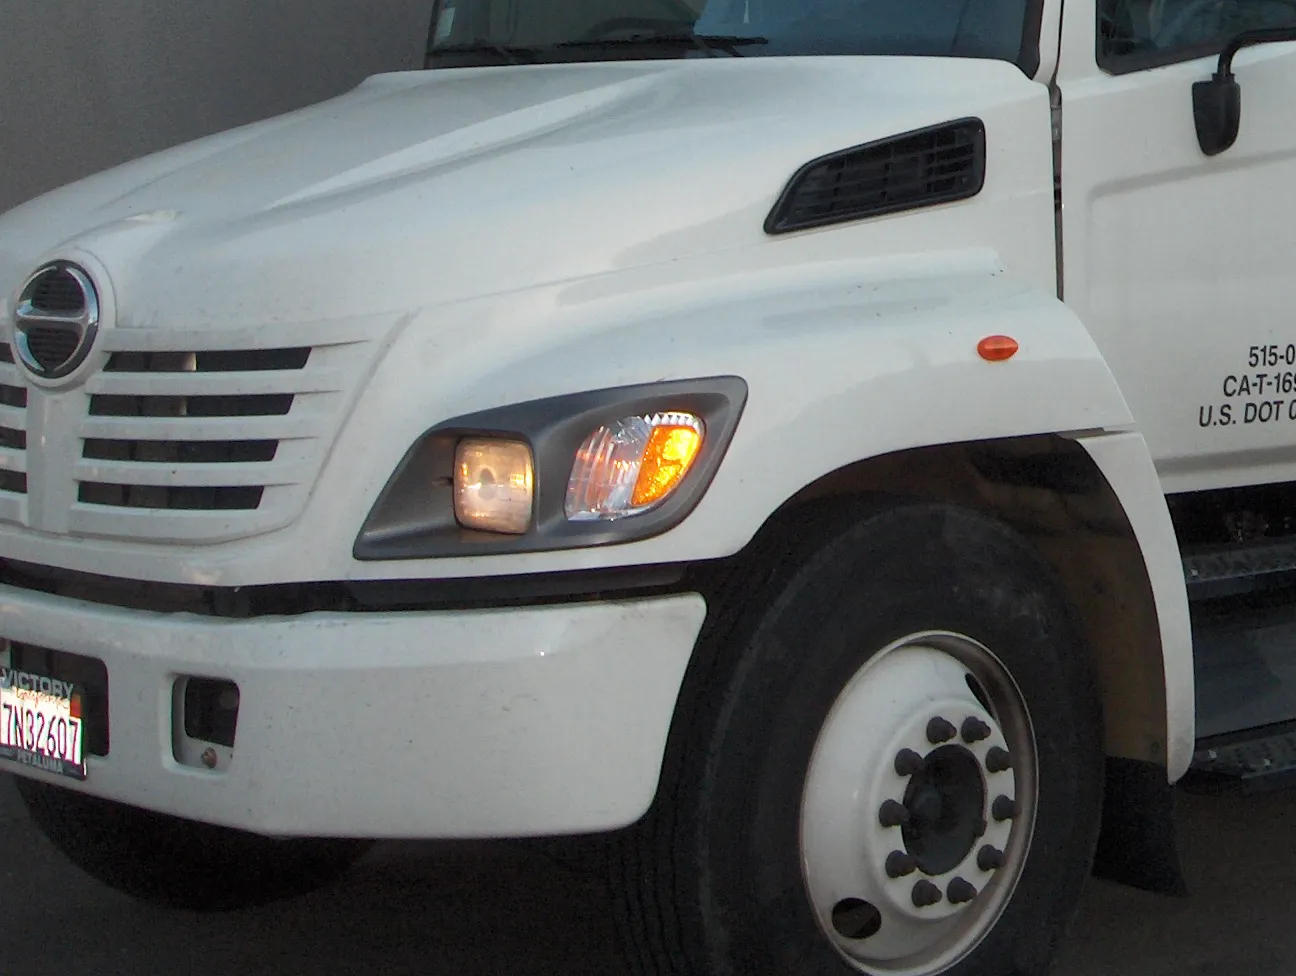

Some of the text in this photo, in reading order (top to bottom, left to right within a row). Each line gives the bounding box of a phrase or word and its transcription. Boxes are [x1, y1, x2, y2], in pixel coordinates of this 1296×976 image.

[1199, 404, 1236, 427] U.S.
[1244, 401, 1284, 423] DOT
[1, 667, 74, 700] VICTORY
[3, 703, 80, 765] 7N32607
